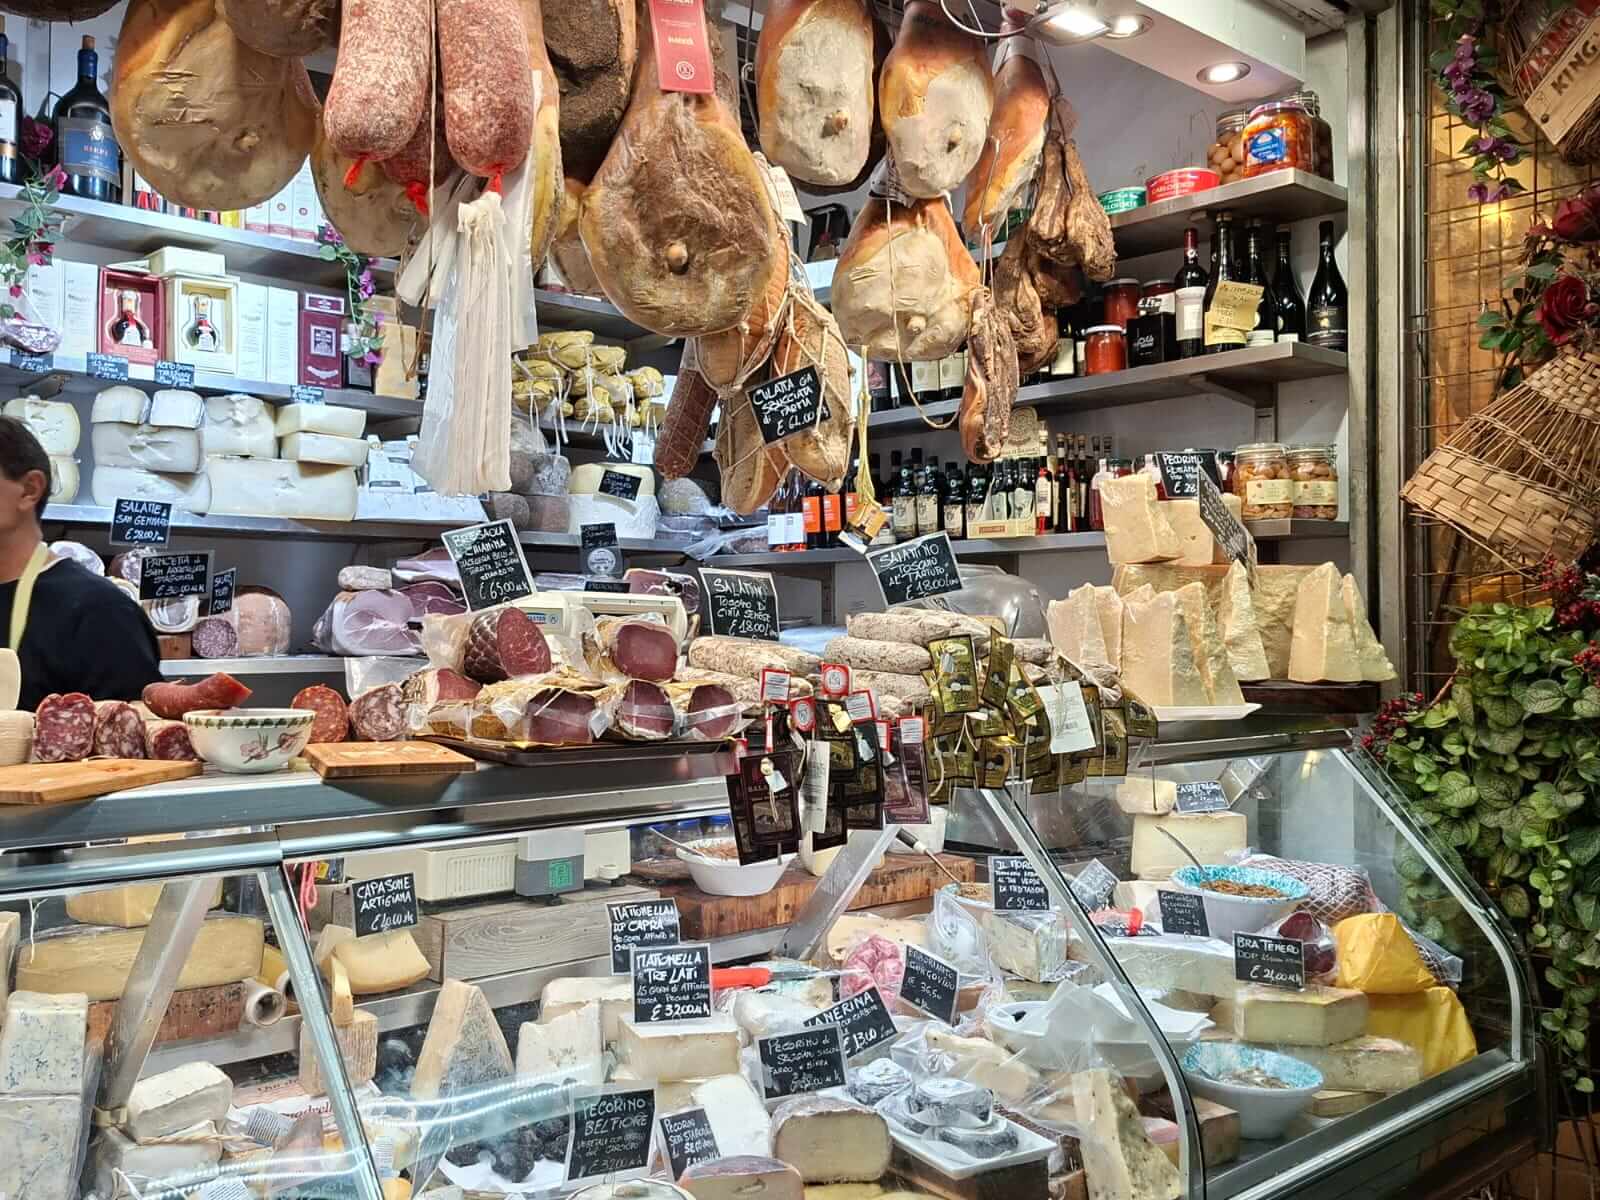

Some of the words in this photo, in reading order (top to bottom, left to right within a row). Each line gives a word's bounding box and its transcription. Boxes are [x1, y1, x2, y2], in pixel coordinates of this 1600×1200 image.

[753, 377, 795, 405] CULATTA
[357, 877, 411, 899] CAPASONE
[627, 918, 665, 932] CAPRA
[1236, 936, 1259, 949] BRA
[1259, 939, 1299, 954] TENERO
[643, 967, 668, 984] TRE
[582, 1098, 647, 1120] PECORINO
